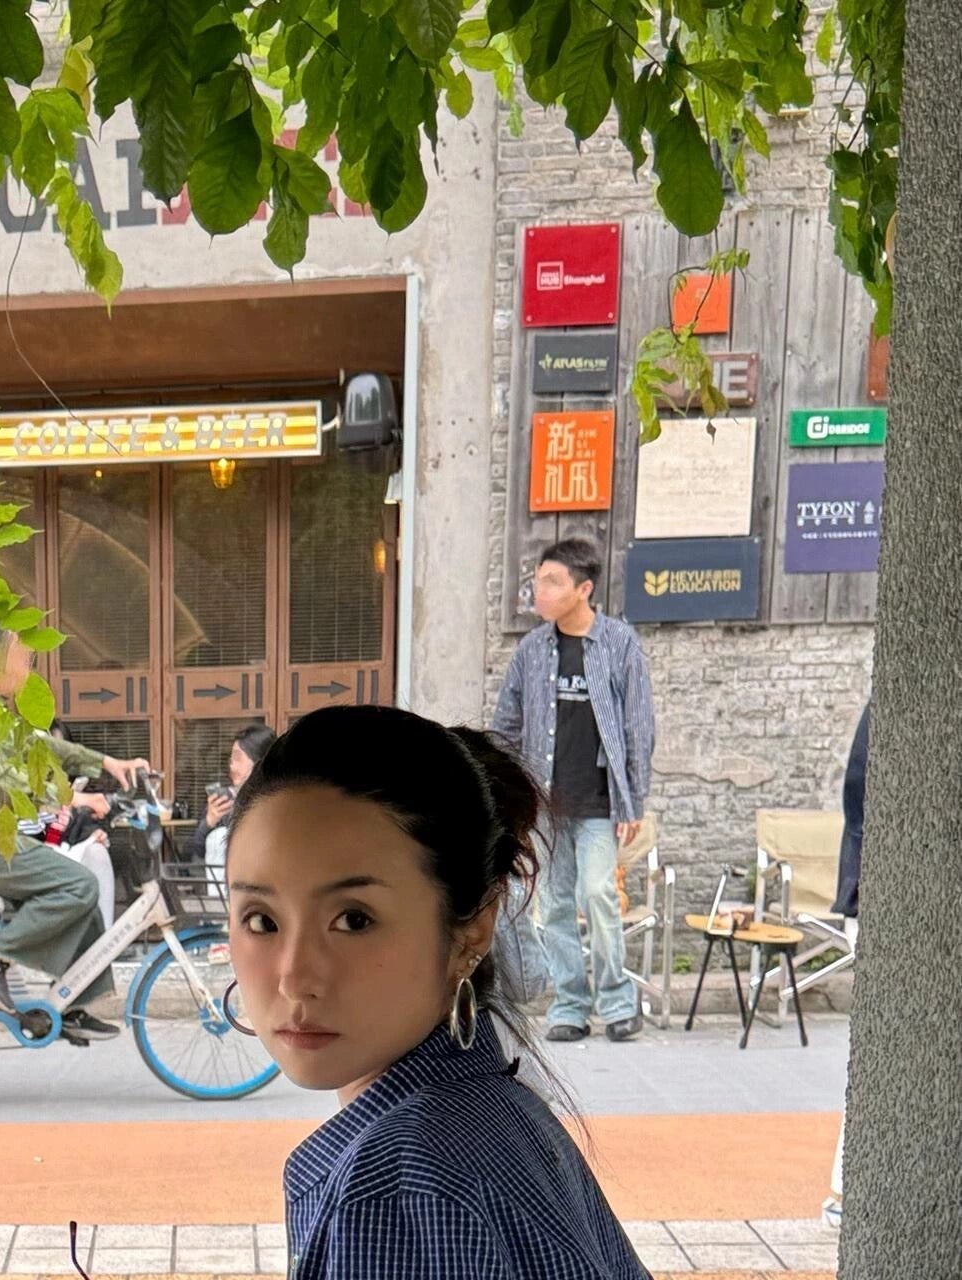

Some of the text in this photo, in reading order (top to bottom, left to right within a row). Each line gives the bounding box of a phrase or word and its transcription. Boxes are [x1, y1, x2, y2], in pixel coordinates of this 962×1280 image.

[14, 411, 287, 455] COFFEE & BEER
[797, 501, 855, 518] TYFON
[669, 580, 741, 593] EDUCATION
